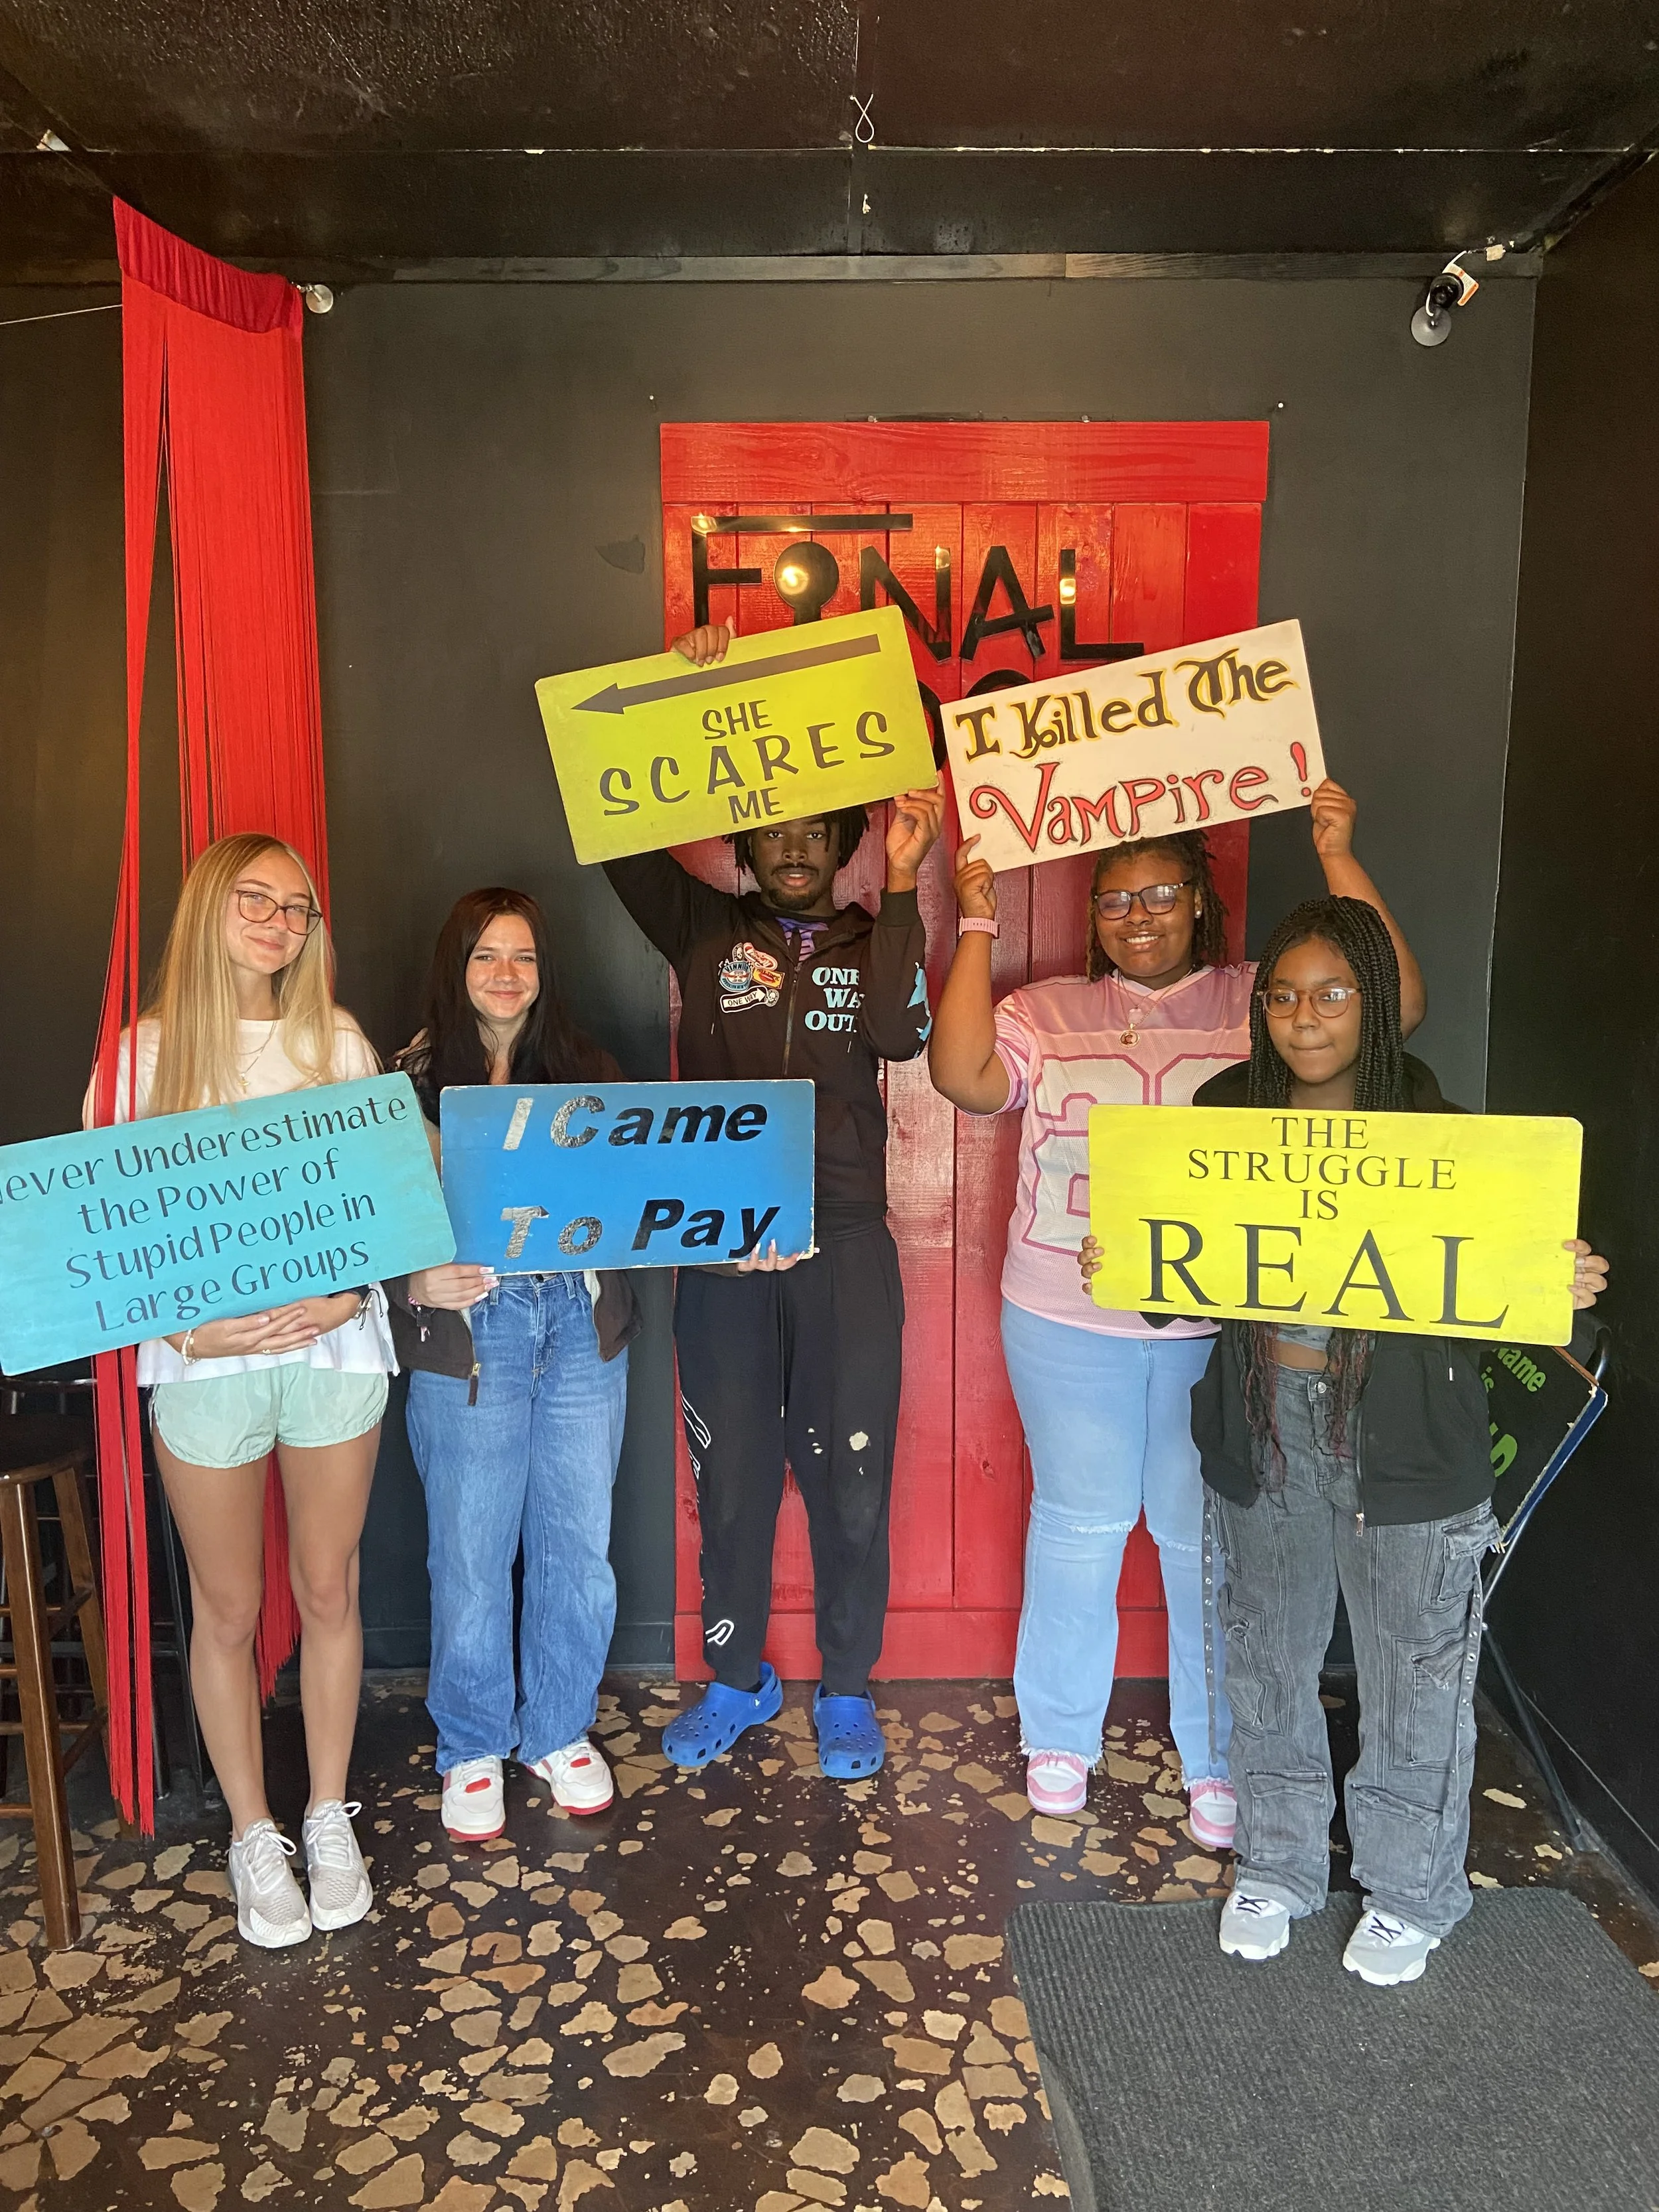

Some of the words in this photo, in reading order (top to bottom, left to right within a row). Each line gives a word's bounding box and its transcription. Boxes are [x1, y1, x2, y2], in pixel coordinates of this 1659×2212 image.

[702, 700, 772, 740] SHE
[956, 706, 999, 760] I
[1009, 670, 1173, 758] Killed
[1175, 648, 1295, 717] The
[600, 711, 895, 816] SCARES
[728, 787, 784, 824] ME
[727, 997, 743, 1006] ONE
[745, 992, 757, 1003] WAY
[823, 987, 865, 1009] WA
[0, 1158, 104, 1205] ever
[114, 1096, 407, 1178] Underestimate
[502, 1097, 534, 1150] I
[550, 1094, 768, 1149] Came
[1271, 1116, 1368, 1149] THE
[78, 1198, 151, 1234] the
[157, 1166, 289, 1218] Power
[301, 1147, 340, 1185] of
[1189, 1149, 1457, 1190] STRUGGLE
[500, 1205, 603, 1259] To
[631, 1199, 780, 1259] Pay
[1297, 1189, 1338, 1220] IS
[66, 1226, 204, 1289] Stupid
[209, 1199, 333, 1254] People
[341, 1192, 376, 1222] in
[95, 1279, 222, 1331] Large
[231, 1240, 370, 1296] Groups
[1138, 1218, 1510, 1329] REAL
